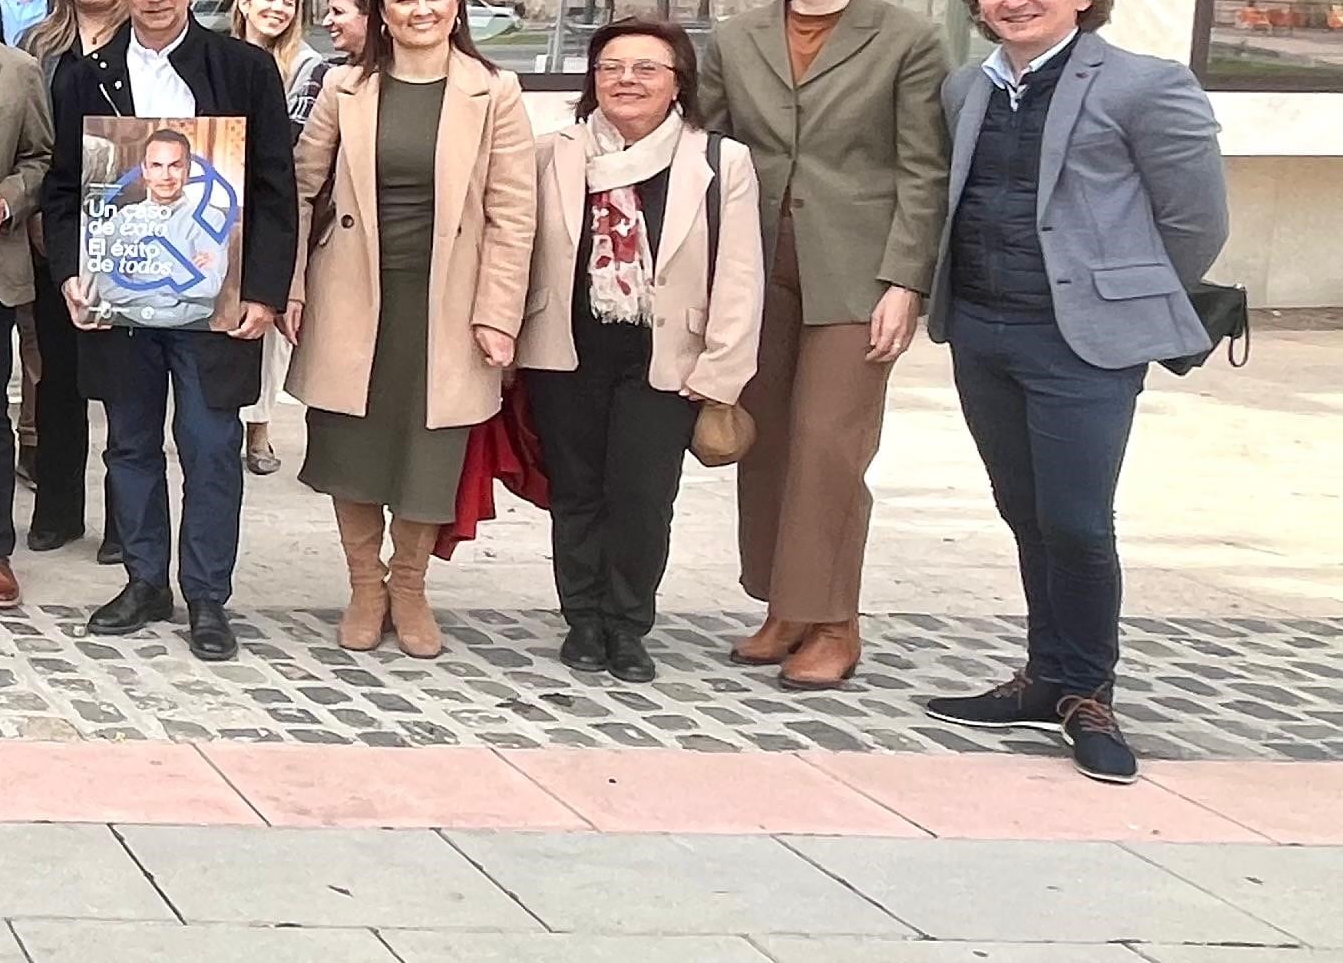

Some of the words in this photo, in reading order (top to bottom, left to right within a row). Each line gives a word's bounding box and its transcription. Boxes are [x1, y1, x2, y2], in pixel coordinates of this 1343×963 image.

[89, 199, 117, 217] Un
[124, 205, 172, 219] caso
[89, 219, 115, 236] de
[89, 239, 106, 256] El
[111, 239, 160, 257] éxito
[87, 255, 114, 273] de
[119, 255, 173, 275] todos
